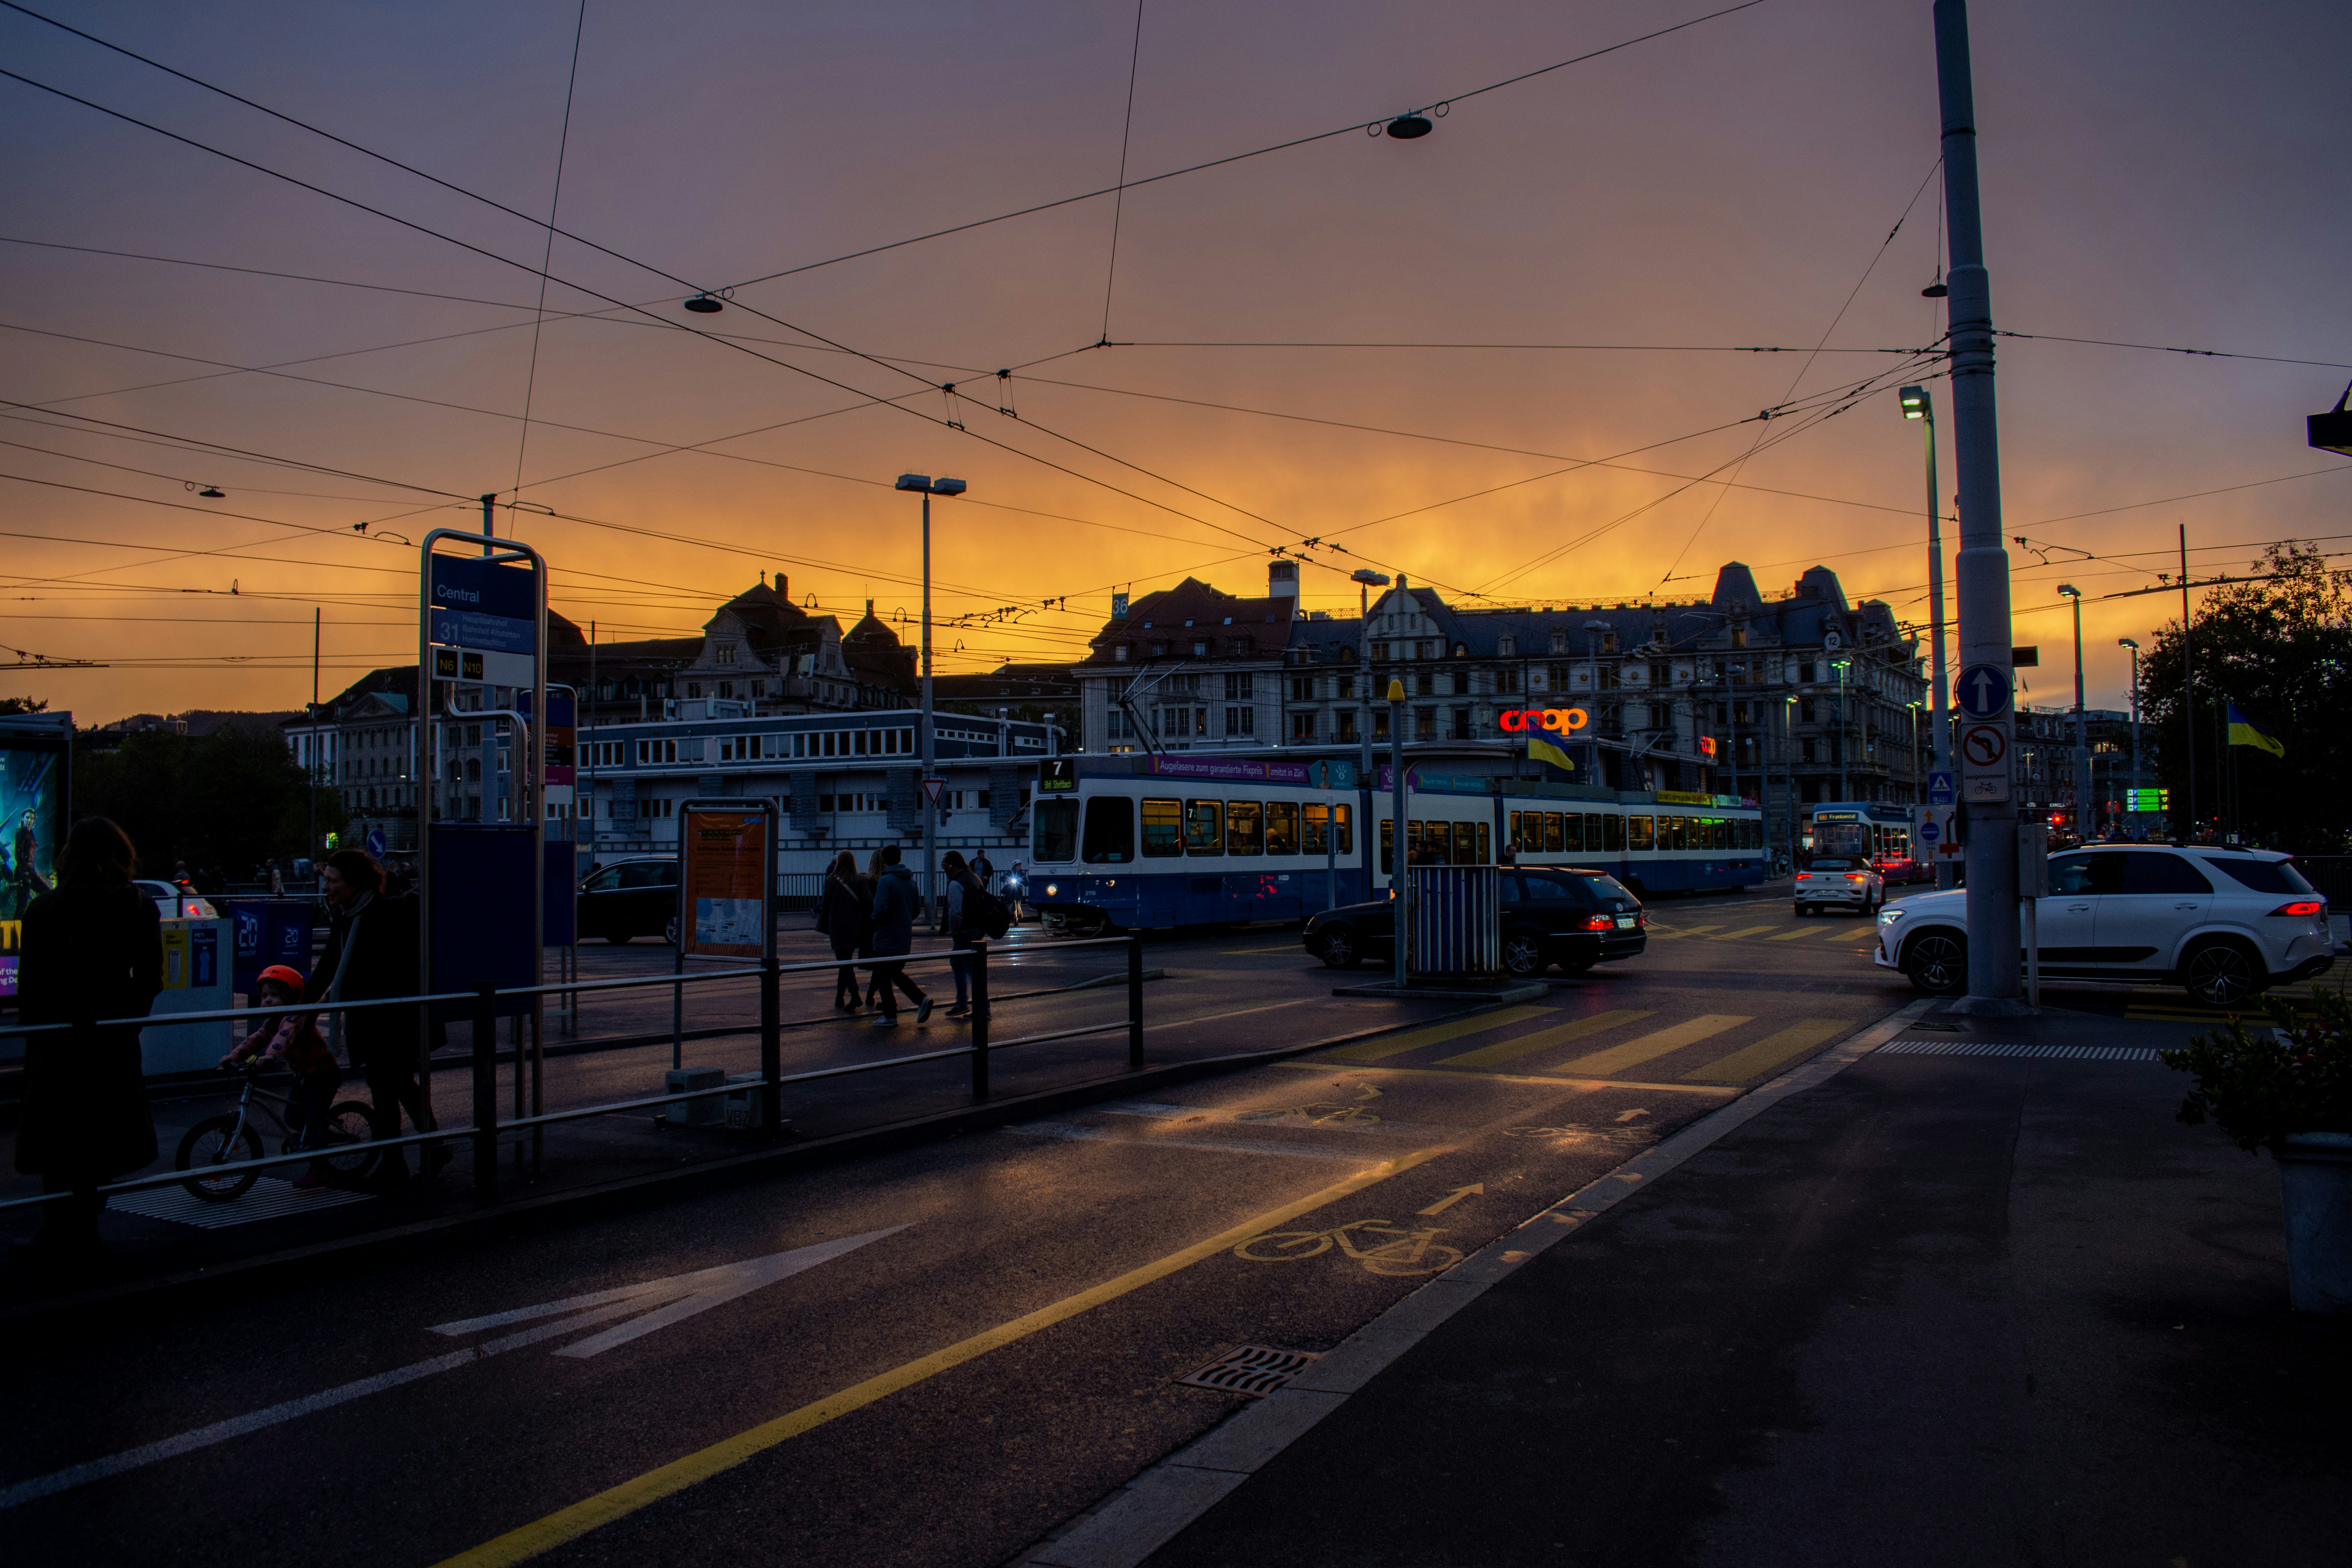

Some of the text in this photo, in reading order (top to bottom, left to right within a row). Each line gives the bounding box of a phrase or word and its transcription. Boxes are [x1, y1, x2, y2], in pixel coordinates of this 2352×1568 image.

[437, 585, 479, 603] Central
[1112, 599, 1128, 614] 36
[462, 614, 507, 626] Hauptbahnhof
[441, 622, 458, 641] 31
[462, 624, 521, 639] Bahnhof Altstetten
[1828, 637, 1837, 645] 12
[439, 659, 454, 671] N6
[463, 661, 481, 674] N10
[1500, 708, 1588, 736] coop
[1700, 735, 1716, 759] coop
[1053, 761, 1063, 775] 7
[1160, 760, 1195, 773] Augelasere
[1210, 764, 1242, 775] garantierte
[1243, 765, 1263, 777] Fixpriis
[1270, 767, 1287, 776] zmitzt
[1294, 768, 1304, 777] Züri
[1188, 808, 1193, 818] 7
[239, 915, 258, 948] 20
[285, 929, 298, 944] 20
[238, 949, 257, 958] minuten
[6, 967, 18, 976] the
[726, 1110, 750, 1127] VBZ
